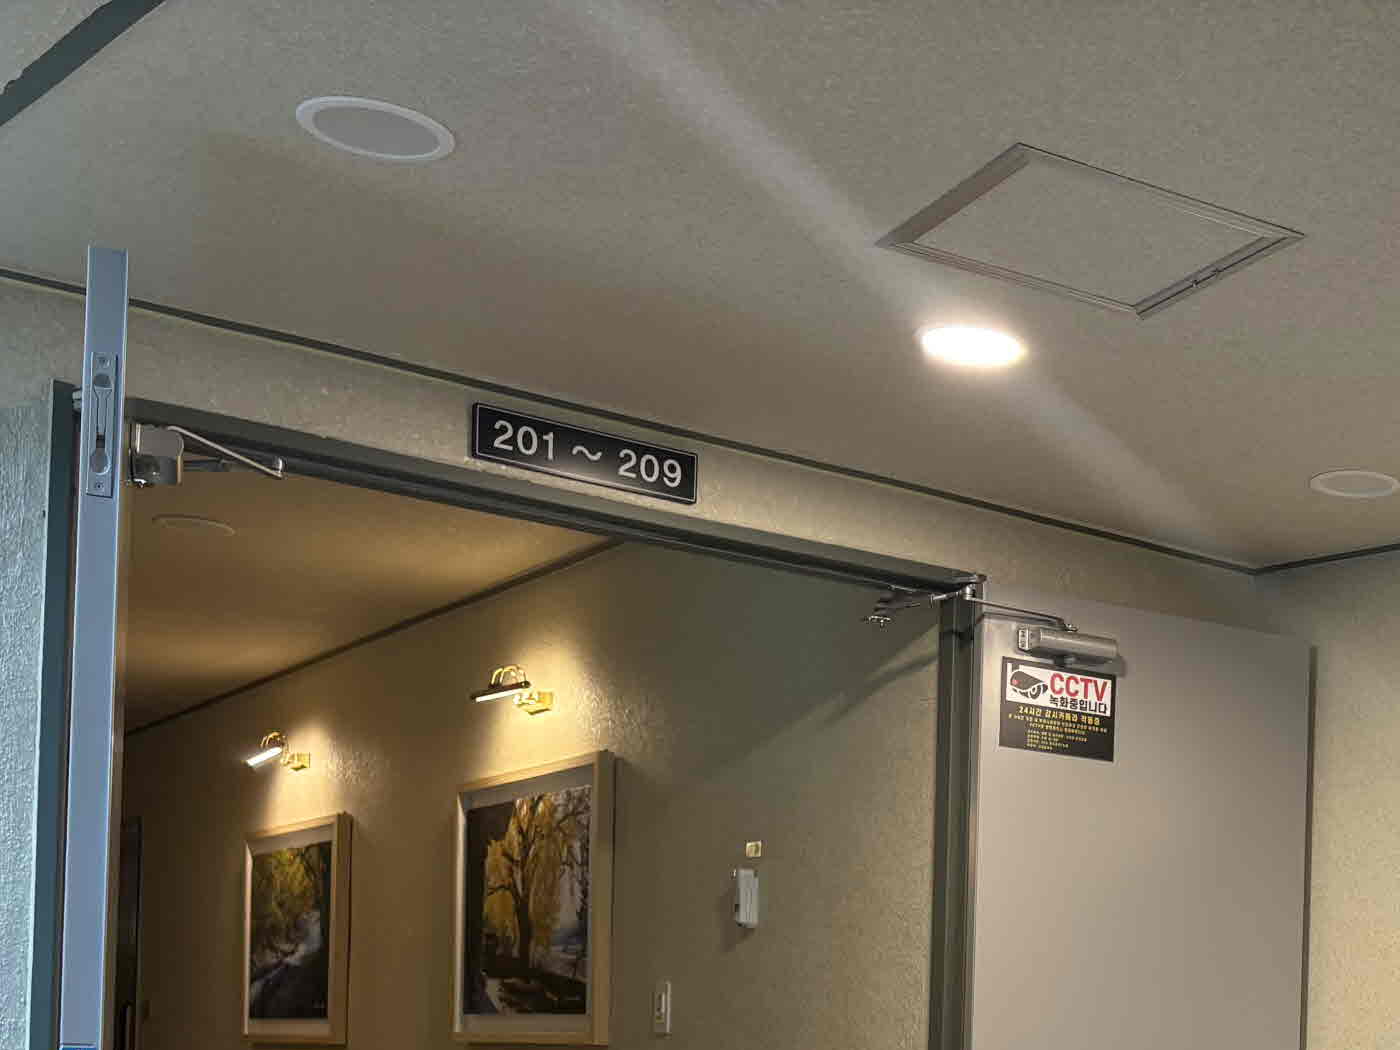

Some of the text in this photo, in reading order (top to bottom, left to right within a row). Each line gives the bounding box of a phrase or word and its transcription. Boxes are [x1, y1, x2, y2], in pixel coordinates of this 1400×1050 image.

[493, 420, 554, 461] 201
[617, 449, 683, 488] 209
[1050, 672, 1108, 702] CCTV
[1018, 705, 1042, 717] 24시간
[1049, 695, 1108, 715] 녹화중입니다
